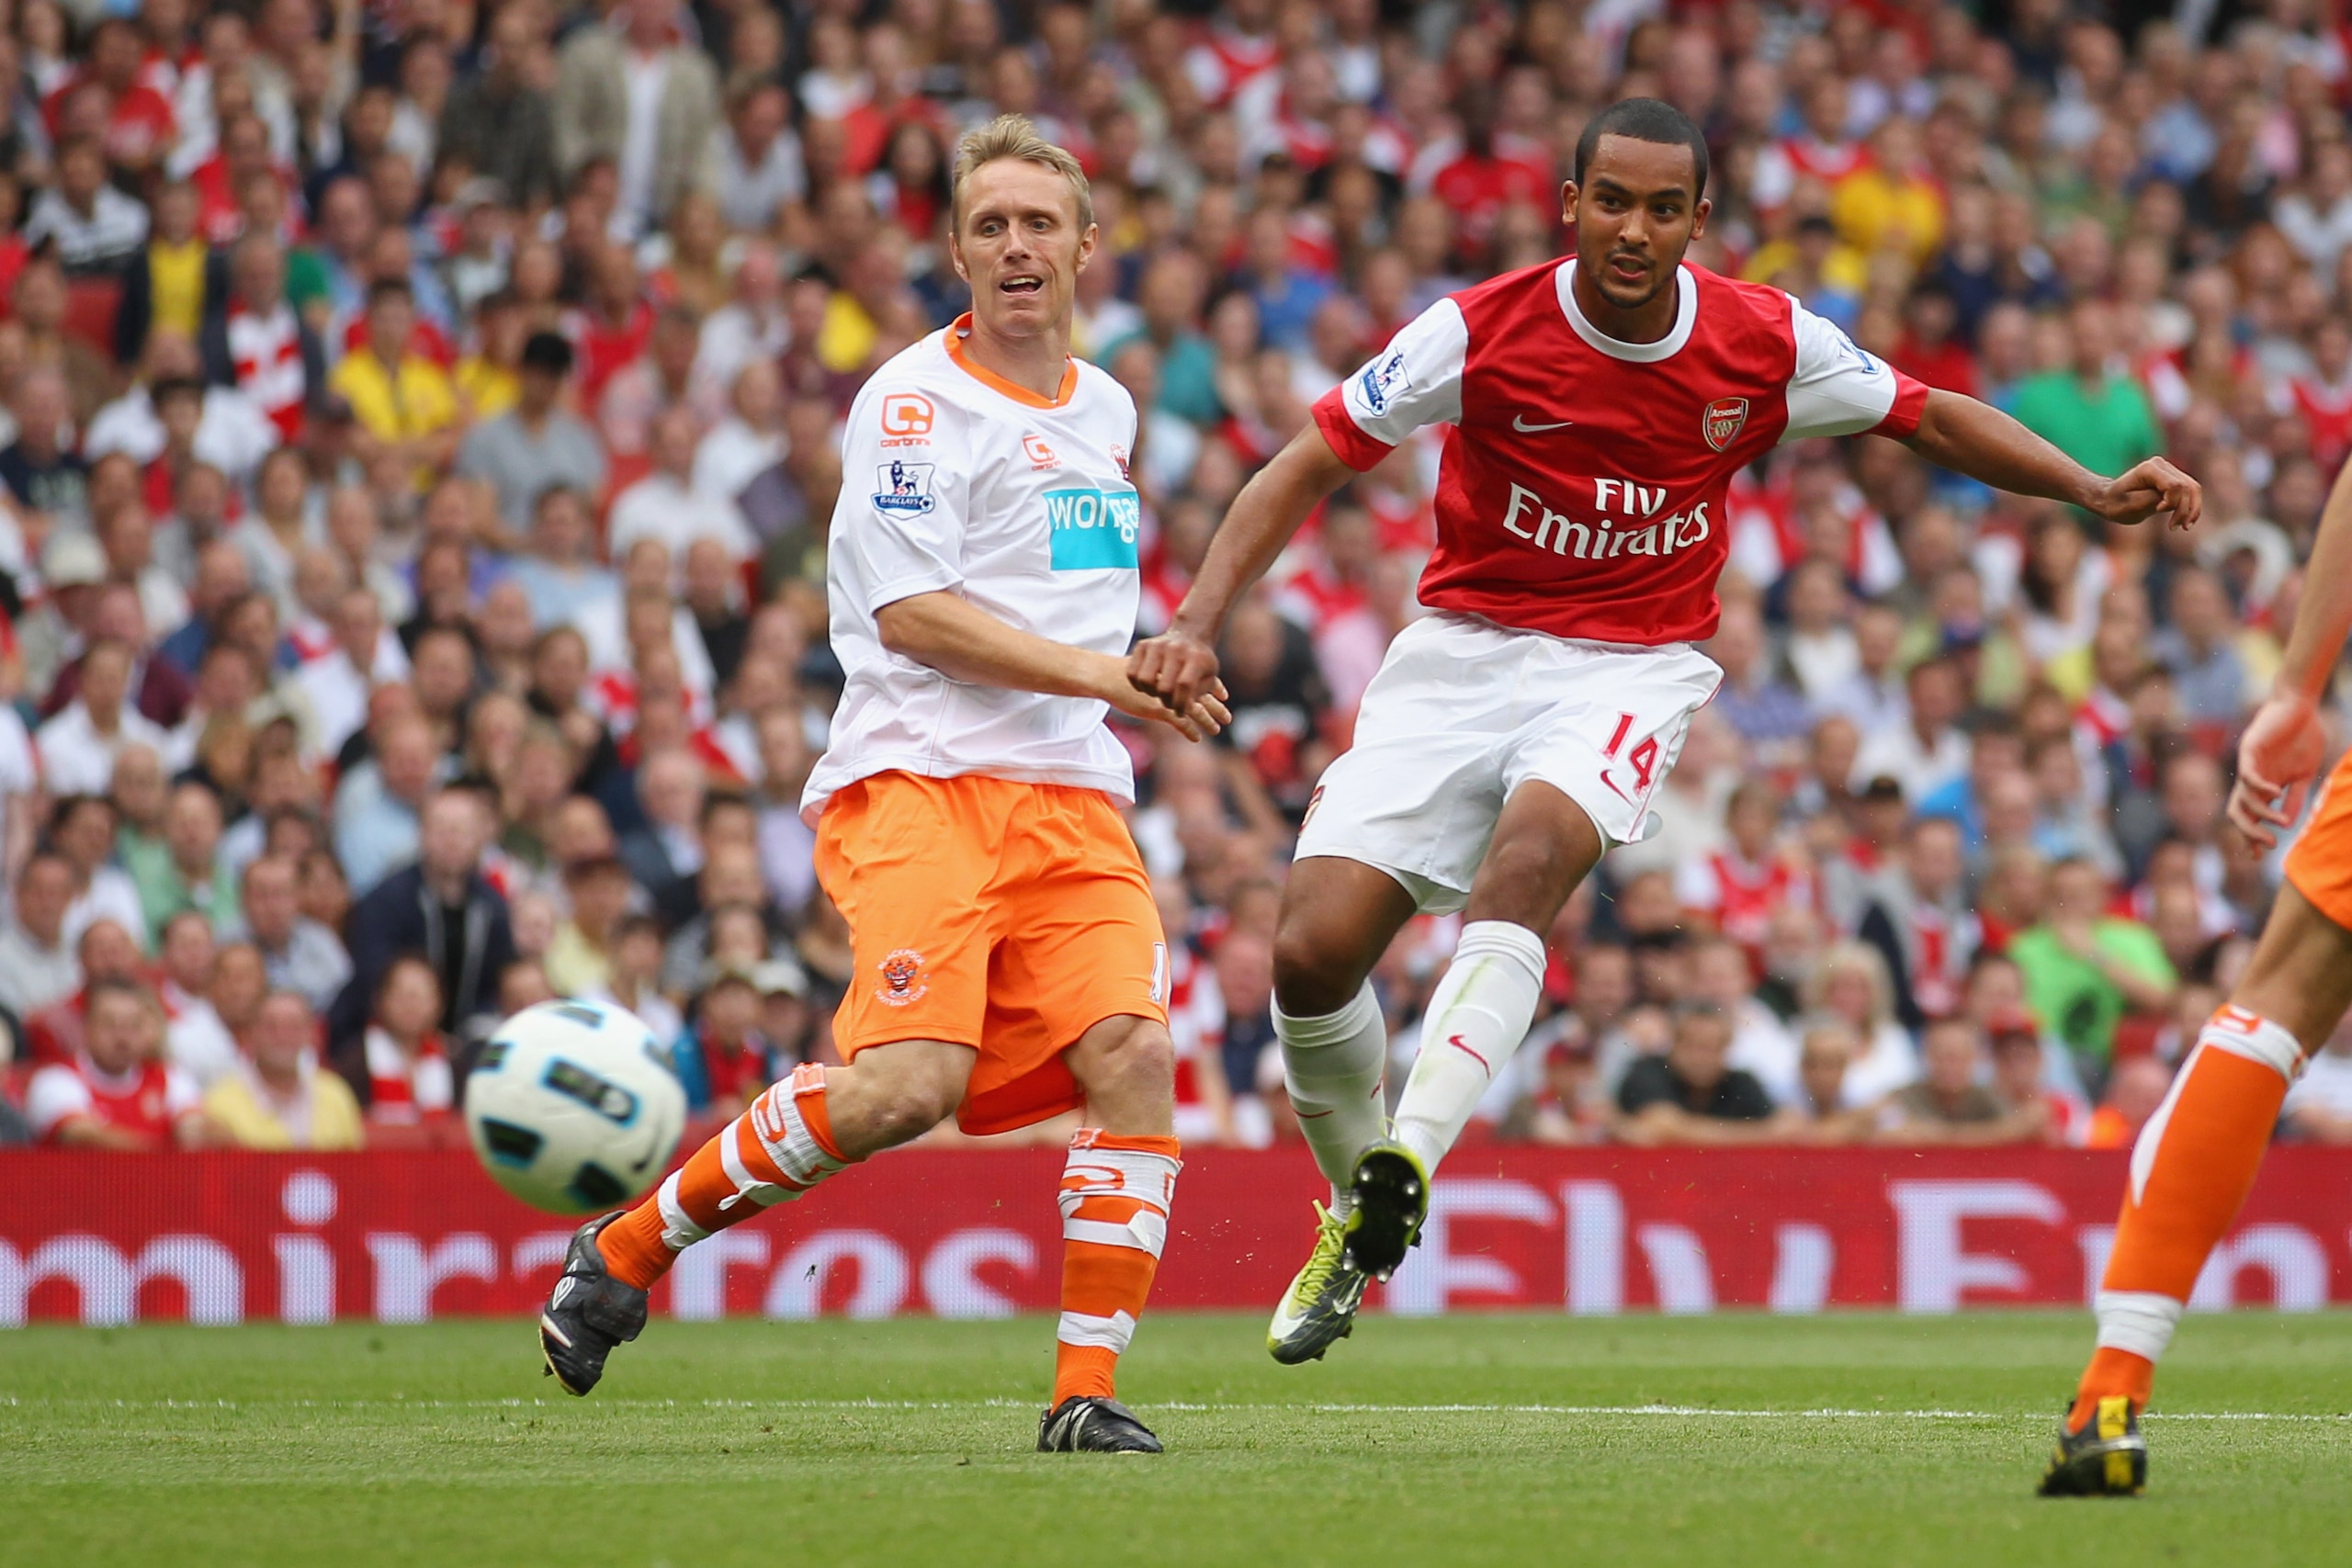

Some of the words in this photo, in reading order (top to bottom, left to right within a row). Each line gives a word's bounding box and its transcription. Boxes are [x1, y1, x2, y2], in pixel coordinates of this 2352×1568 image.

[1711, 406, 1741, 418] Arsenal
[879, 497, 918, 505] BARCLAYS
[1594, 477, 1667, 520] Fly
[1501, 481, 1710, 560] Emirates
[1600, 709, 1659, 800] 14
